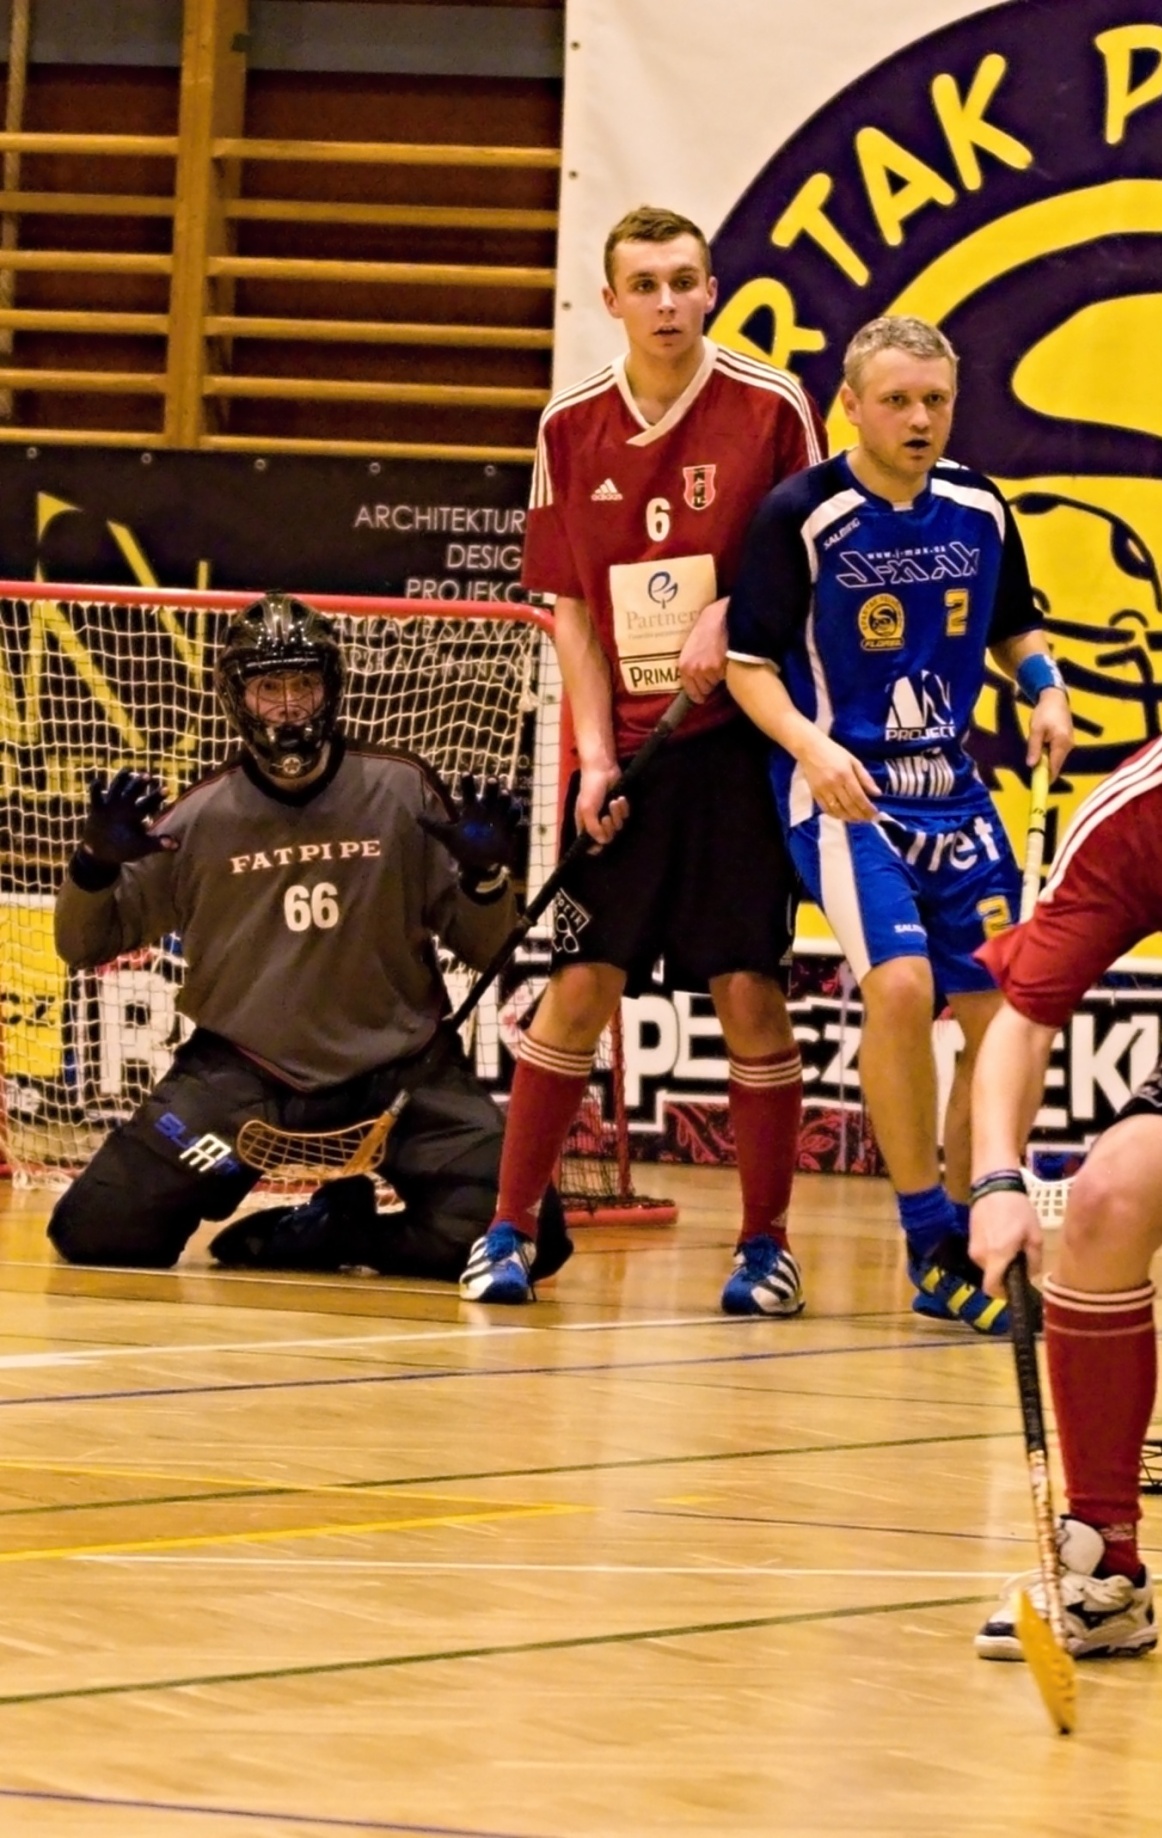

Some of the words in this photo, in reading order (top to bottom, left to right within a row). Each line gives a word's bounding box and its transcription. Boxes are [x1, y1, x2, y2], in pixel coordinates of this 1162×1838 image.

[645, 497, 671, 542] 6
[625, 609, 701, 631] Partner
[944, 587, 970, 637] 2
[884, 725, 956, 742] PROJECT
[282, 881, 340, 933] 66
[976, 894, 1012, 939] 2
